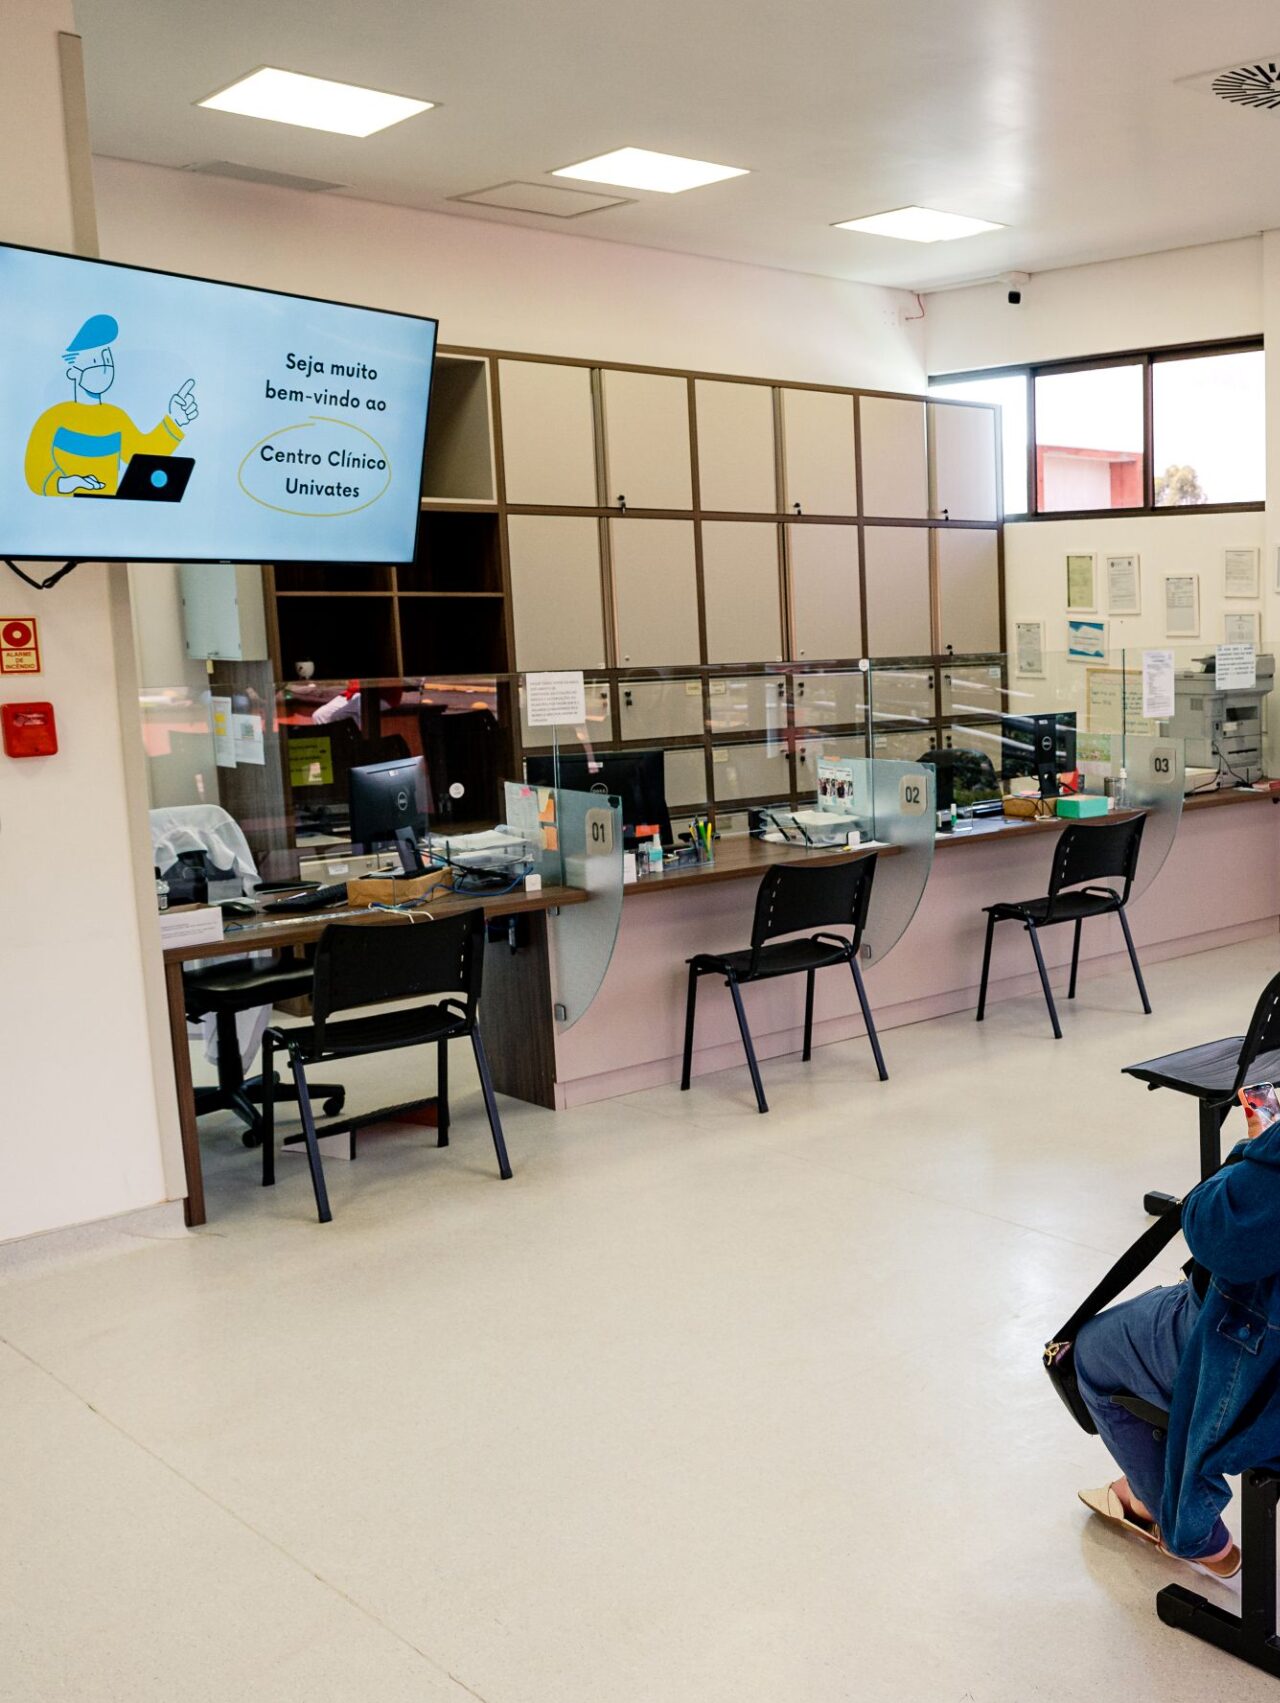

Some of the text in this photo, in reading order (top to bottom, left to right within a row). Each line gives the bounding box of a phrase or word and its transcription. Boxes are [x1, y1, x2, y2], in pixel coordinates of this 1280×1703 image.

[285, 352, 378, 381] Seja muito
[265, 379, 387, 412] bem-vindo ao
[260, 445, 387, 471] Centro Clínico
[285, 477, 360, 498] Univates
[1154, 757, 1170, 773] 03
[905, 786, 921, 804] 02
[591, 822, 606, 843] 01
